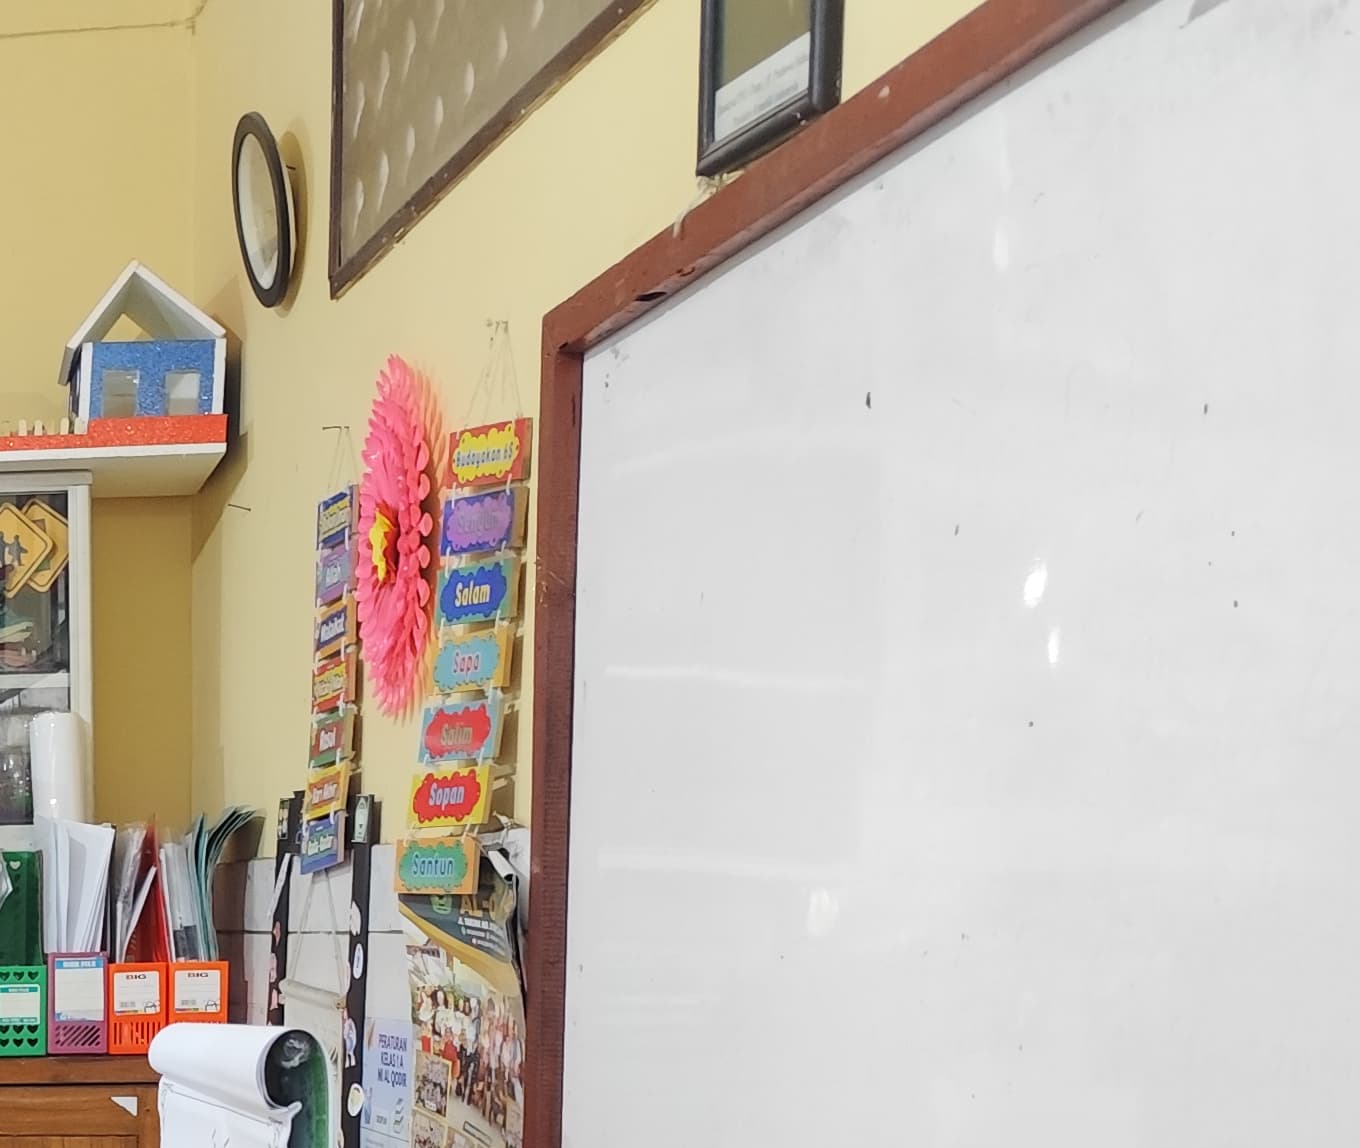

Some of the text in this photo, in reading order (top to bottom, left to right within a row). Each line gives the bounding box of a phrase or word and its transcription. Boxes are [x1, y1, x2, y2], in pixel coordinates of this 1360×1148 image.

[454, 580, 491, 608] Salam
[452, 652, 480, 679] Sapa
[429, 783, 464, 810] Sopan
[412, 851, 455, 877] Santun
